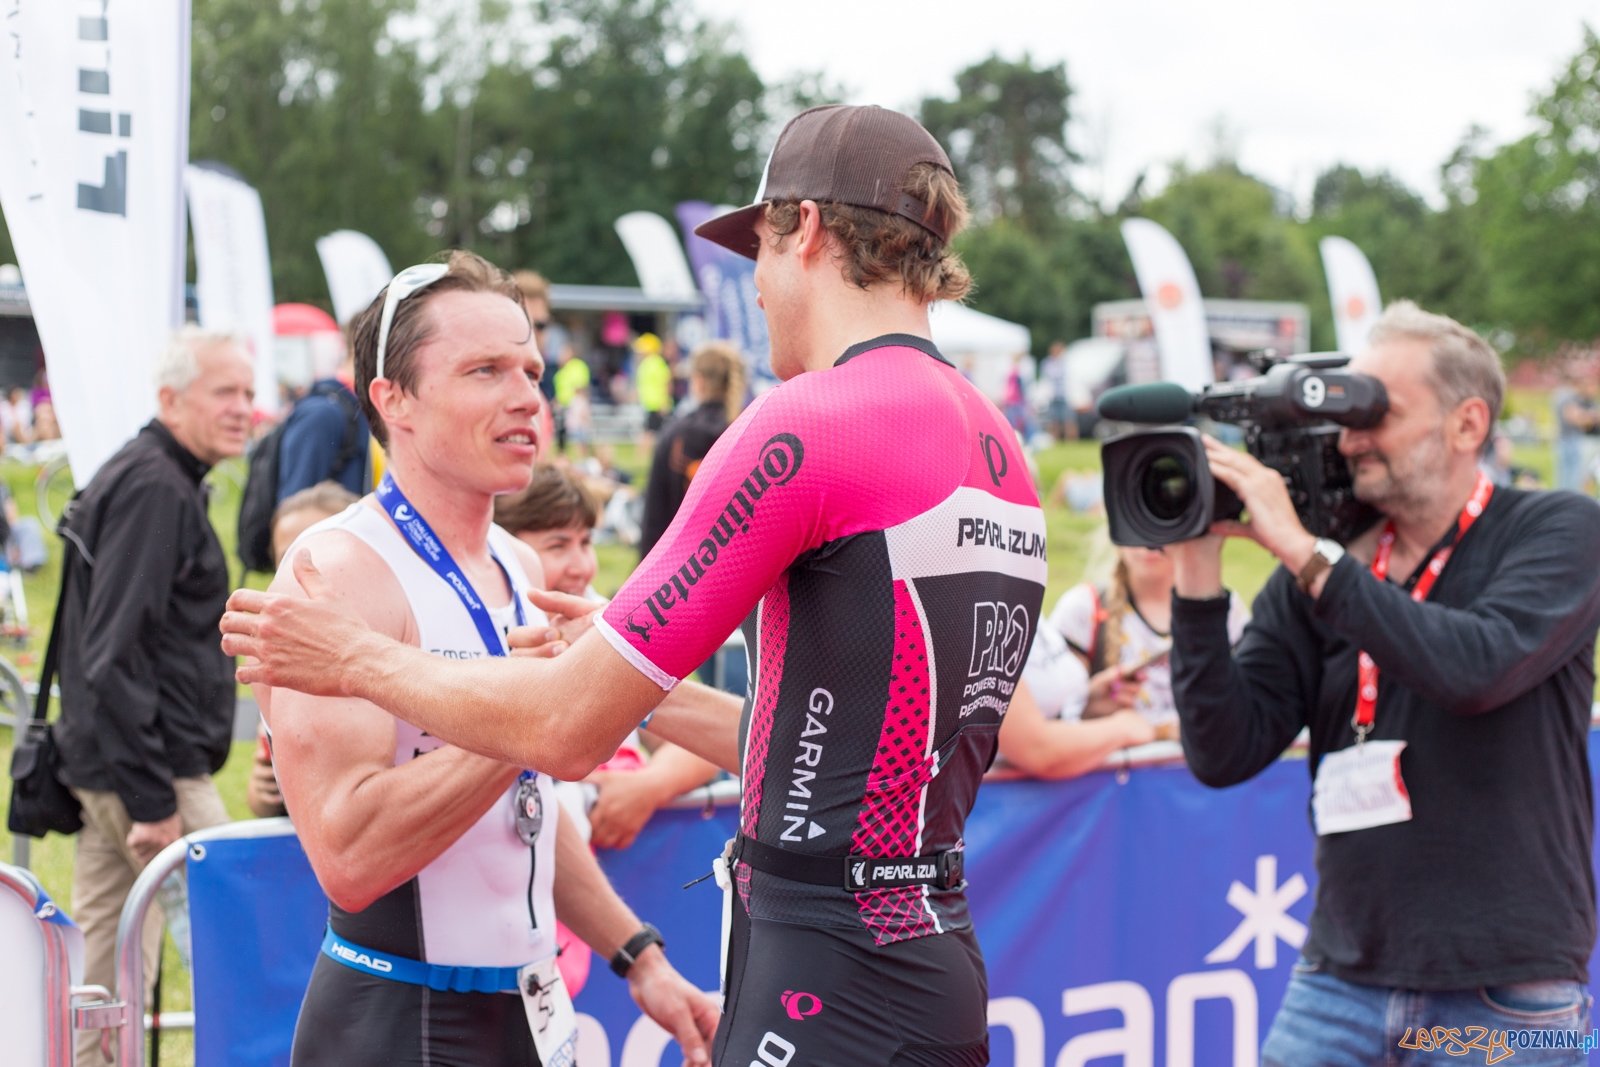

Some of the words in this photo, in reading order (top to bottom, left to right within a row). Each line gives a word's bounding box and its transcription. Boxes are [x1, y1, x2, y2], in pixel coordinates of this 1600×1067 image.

[1303, 376, 1325, 408] 9
[643, 432, 805, 628] Continental
[957, 517, 1006, 551] PEARL
[968, 601, 1030, 677] PRO
[963, 676, 997, 698] POWERS
[779, 687, 834, 842] GARMIN
[872, 864, 916, 880] PEARL
[331, 941, 393, 973] HEAD
